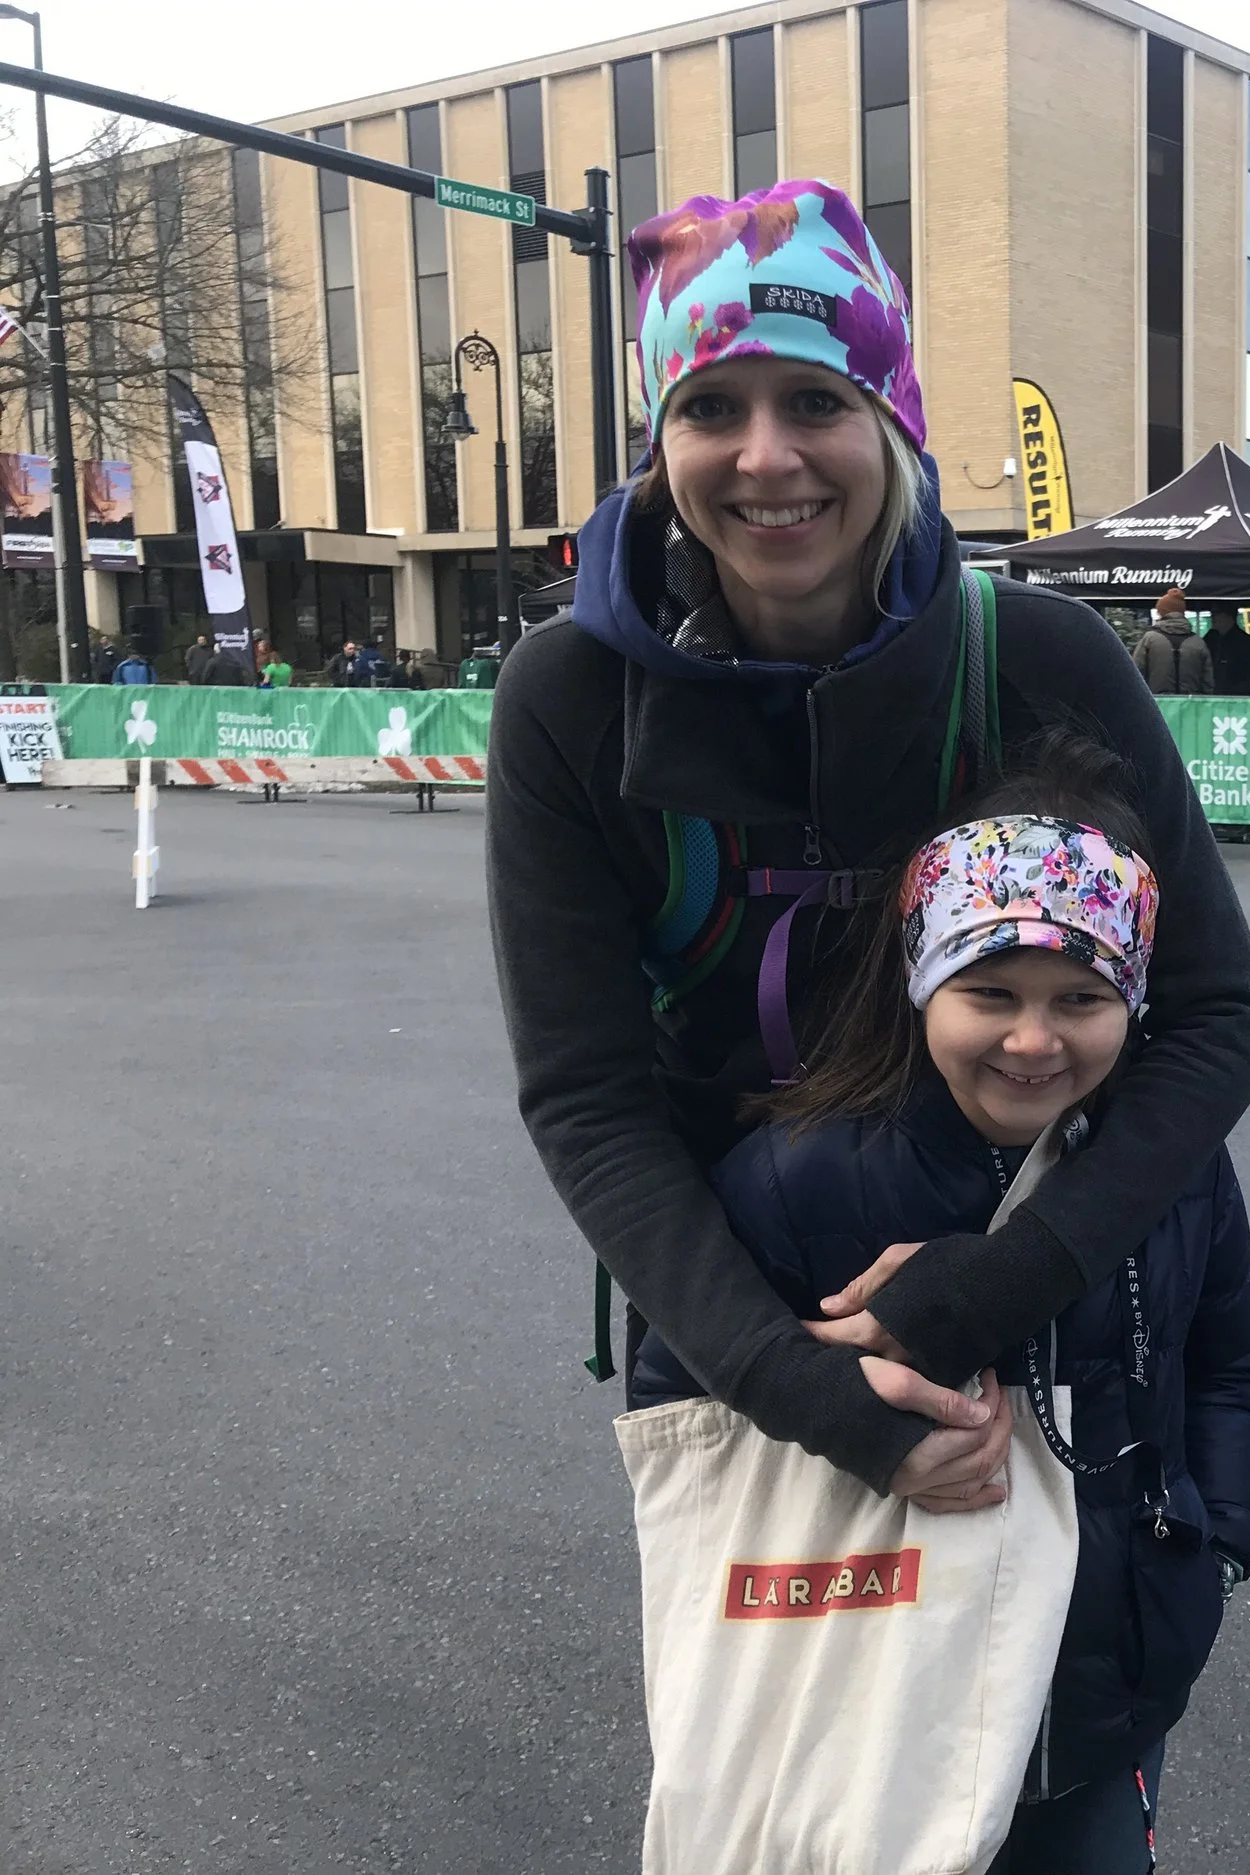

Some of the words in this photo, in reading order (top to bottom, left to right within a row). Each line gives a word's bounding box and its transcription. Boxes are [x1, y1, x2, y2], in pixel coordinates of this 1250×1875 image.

[440, 183, 511, 215] Merrimack
[515, 200, 530, 219] St
[767, 287, 824, 305] SKIDA
[1094, 514, 1206, 531] Millennium
[1103, 526, 1193, 541] Running
[1026, 566, 1109, 586] Millennium
[1111, 564, 1194, 589] Running
[7, 733, 47, 748] KICK
[217, 726, 310, 750] SHAMROCK
[7, 747, 56, 762] HERE!
[1126, 1251, 1140, 1293] RES
[1134, 1311, 1143, 1327] BY
